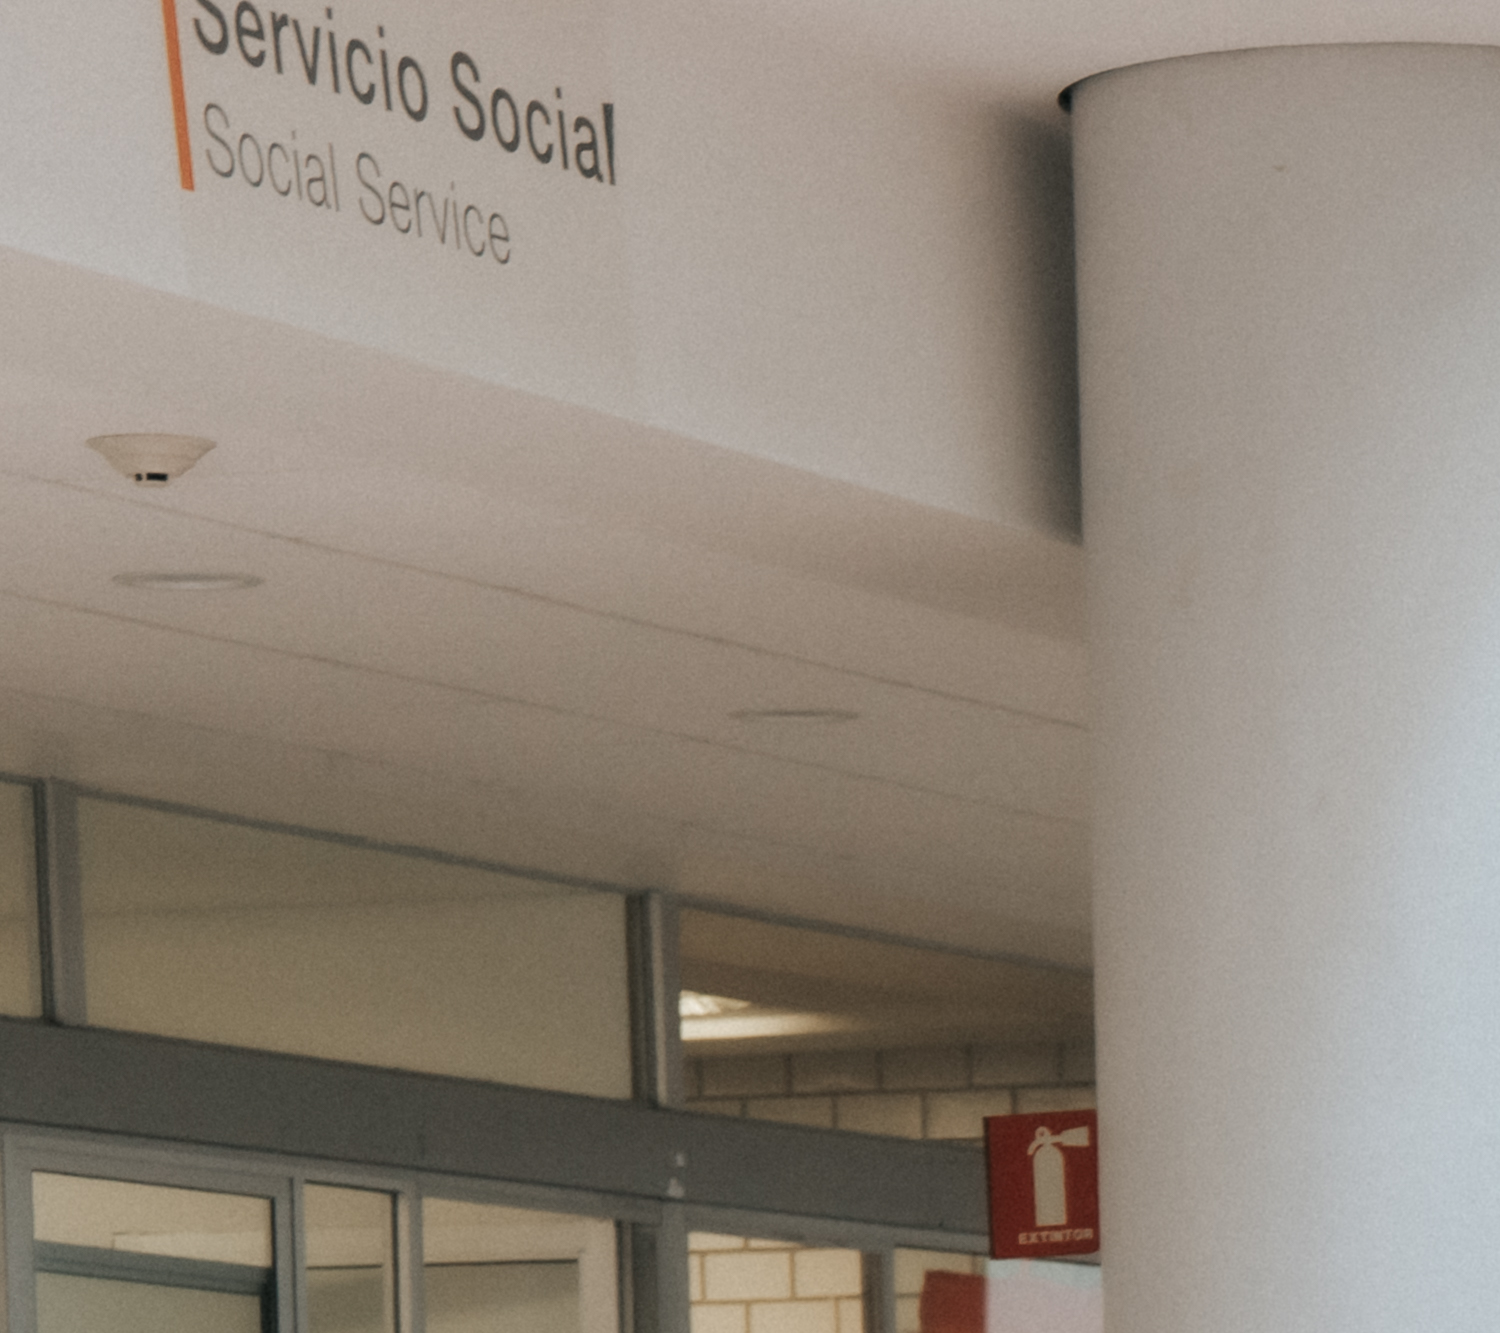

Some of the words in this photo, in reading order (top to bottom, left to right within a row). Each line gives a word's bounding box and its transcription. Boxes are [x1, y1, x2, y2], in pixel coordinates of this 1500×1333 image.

[195, 0, 429, 122] Servicio
[450, 50, 618, 186] Social
[203, 103, 341, 213] Social
[355, 151, 512, 265] Service
[1018, 1228, 1094, 1245] EXTINTOR
